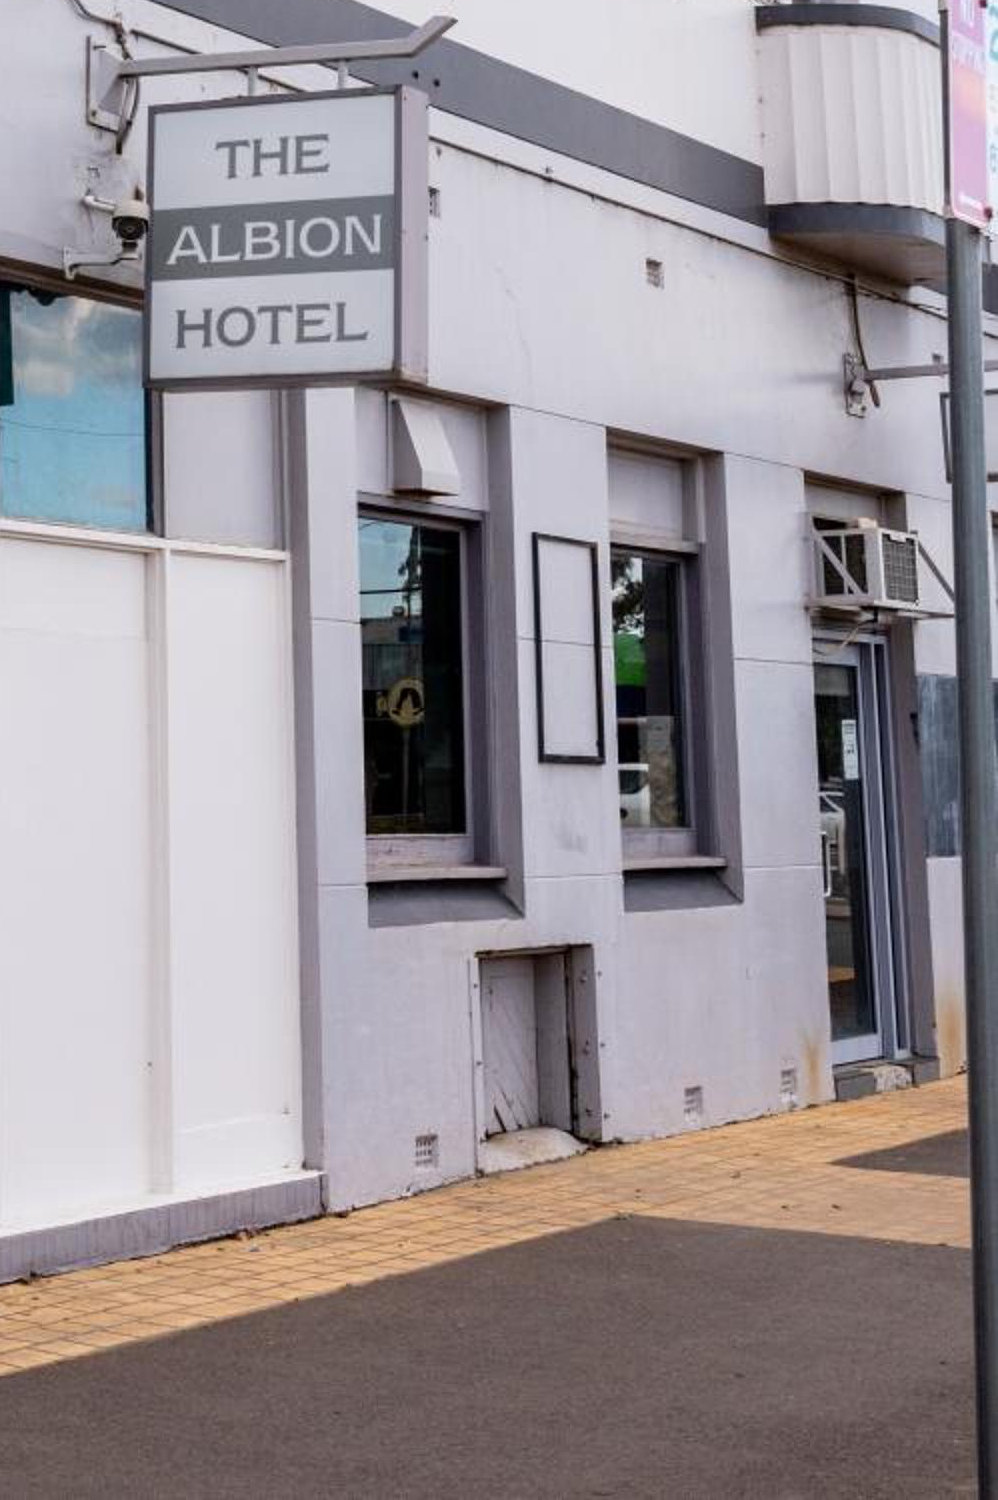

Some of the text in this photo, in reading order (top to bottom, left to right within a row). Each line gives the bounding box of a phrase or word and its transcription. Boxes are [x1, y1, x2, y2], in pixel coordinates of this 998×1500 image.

[214, 133, 330, 180] THE
[166, 212, 383, 266] ALBION
[174, 301, 369, 350] HOTEL
